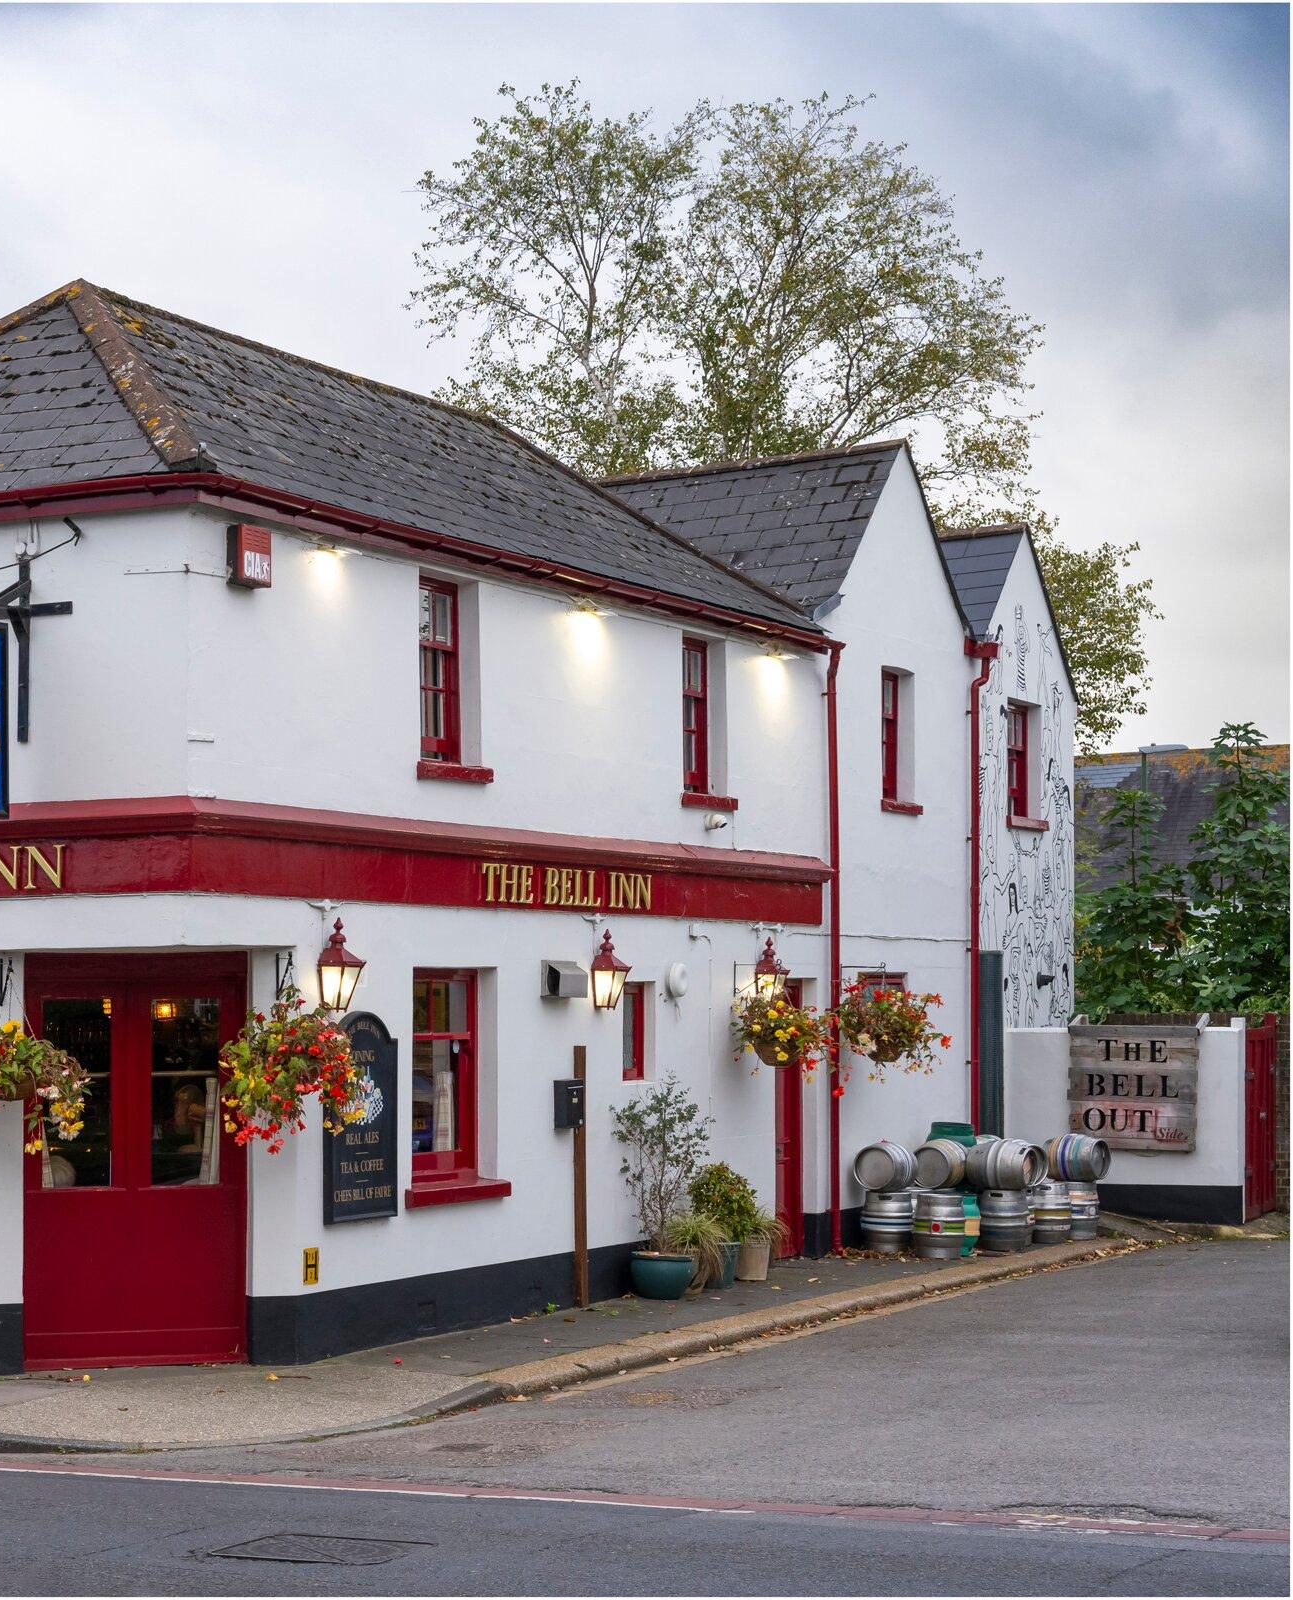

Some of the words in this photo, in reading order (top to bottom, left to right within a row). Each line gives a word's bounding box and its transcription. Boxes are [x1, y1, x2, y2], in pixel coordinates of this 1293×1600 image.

[482, 863, 534, 904] THE
[545, 867, 601, 907] BELL
[609, 872, 652, 910] INN
[1098, 1039, 1168, 1063] THE
[1086, 1073, 1180, 1098] BELL
[345, 1132, 363, 1146] REAL
[364, 1131, 380, 1144] ALES
[340, 1161, 353, 1174] TEA
[353, 1161, 359, 1173] &
[360, 1158, 385, 1173] COFFEE
[353, 1188, 365, 1201] BILL
[365, 1187, 373, 1199] OF
[374, 1185, 391, 1199] FAYRE
